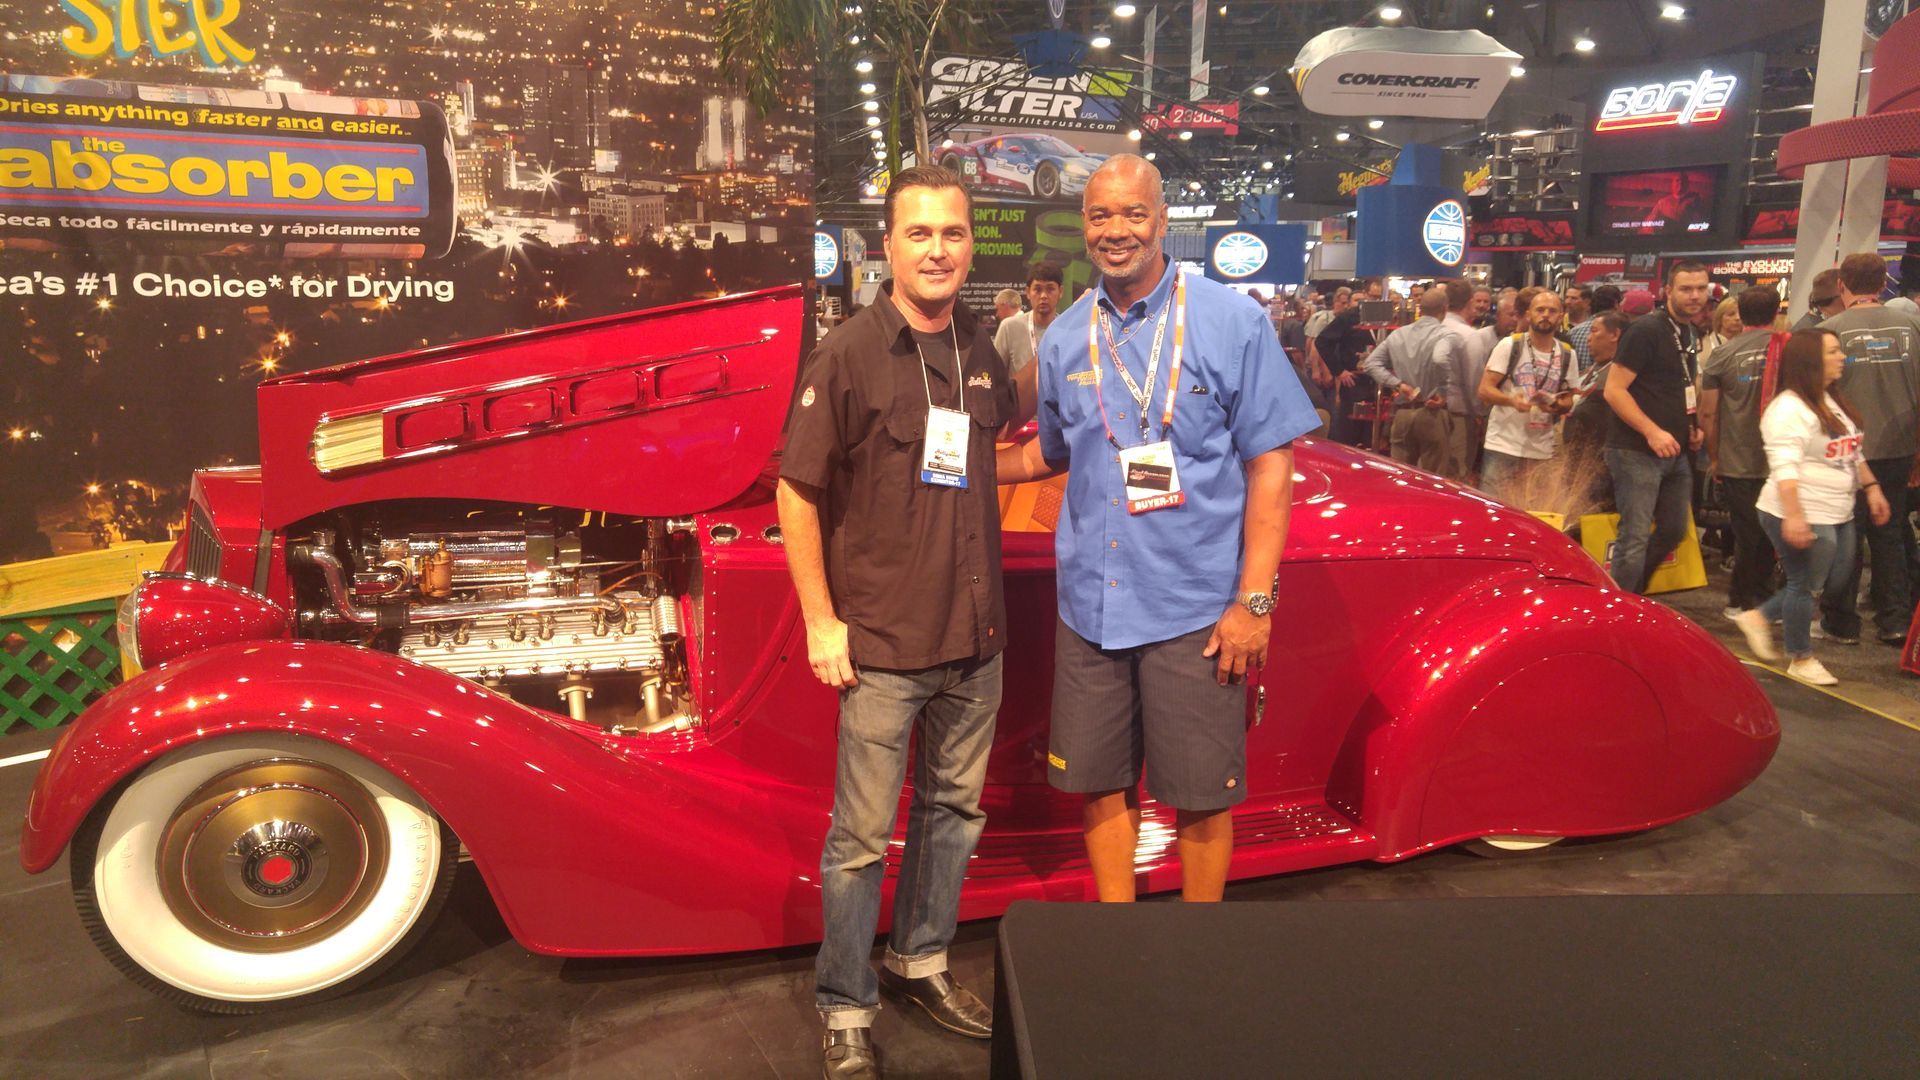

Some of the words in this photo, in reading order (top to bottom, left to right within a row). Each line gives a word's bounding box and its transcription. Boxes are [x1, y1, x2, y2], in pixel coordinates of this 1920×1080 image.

[931, 57, 1093, 92] GREEN
[1337, 72, 1481, 89] COVERCRAFT
[925, 84, 1083, 118] FILTER
[65, 102, 189, 126] anything
[198, 108, 272, 127] faster
[277, 115, 324, 131] and
[331, 120, 403, 135] easier.
[1080, 111, 1099, 120] USA
[81, 137, 126, 153] the
[0, 140, 415, 202] absorber
[964, 161, 977, 175] 68
[974, 208, 998, 222] SN'T
[999, 209, 1026, 223] JUST
[0, 213, 51, 228] Seca
[58, 216, 119, 229] todo
[126, 217, 254, 234] fácilmente
[259, 223, 274, 237] y
[282, 222, 421, 238] rápidamente
[974, 226, 1002, 238] SION.
[973, 242, 1023, 256] PROVING
[1582, 257, 1618, 265] OWERED
[1725, 261, 1742, 269] THE
[1713, 266, 1749, 275] BORLA
[75, 272, 118, 296] #1
[290, 275, 338, 298] for
[347, 275, 455, 303] Drying
[1134, 494, 1179, 510] BUYER-17
